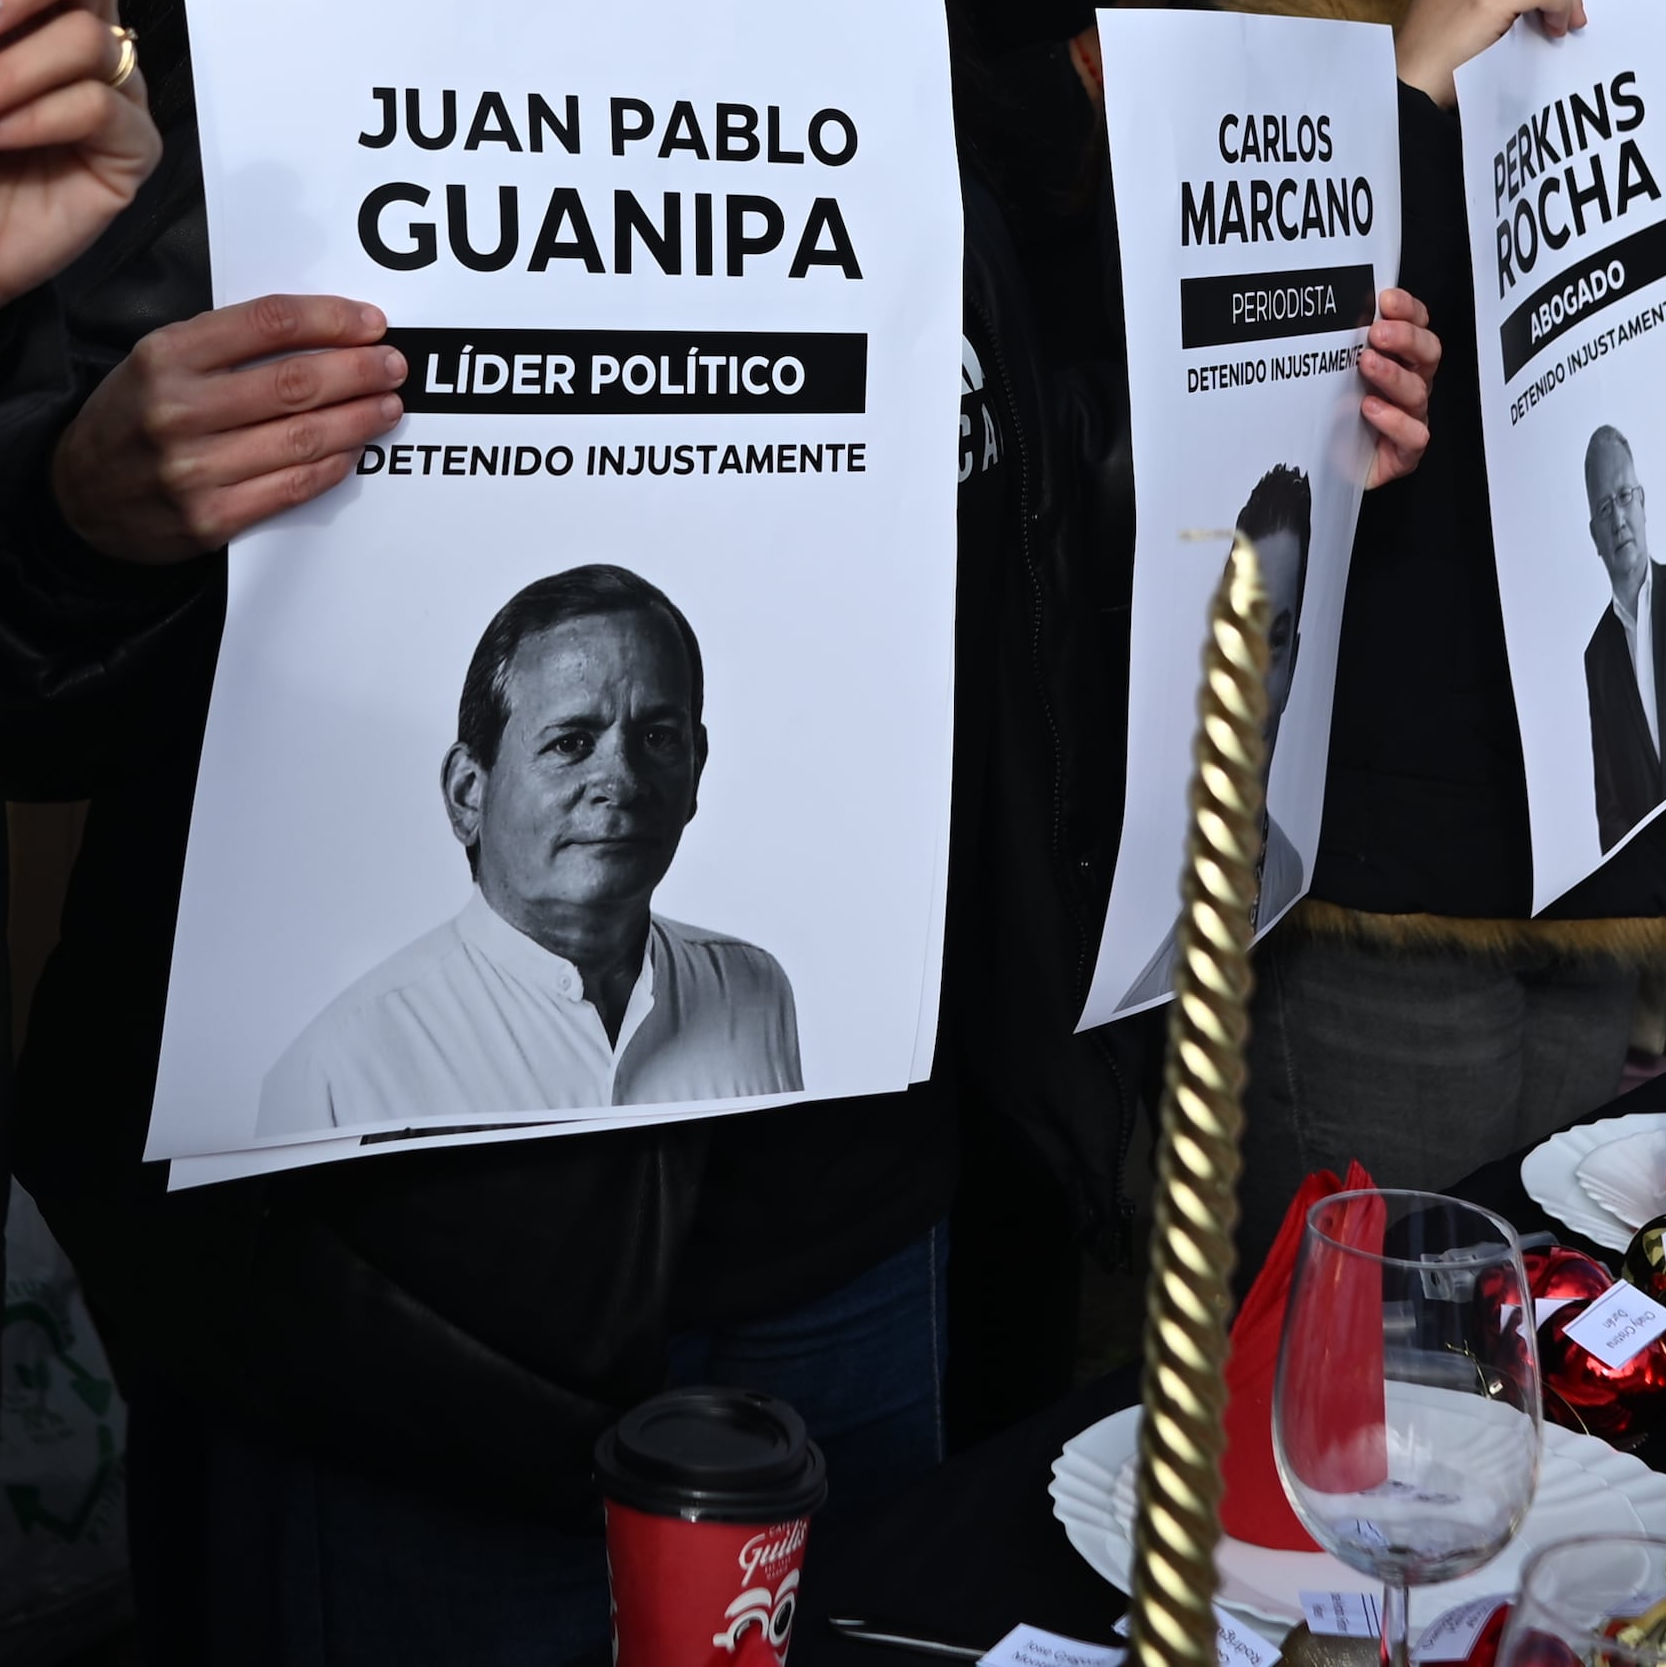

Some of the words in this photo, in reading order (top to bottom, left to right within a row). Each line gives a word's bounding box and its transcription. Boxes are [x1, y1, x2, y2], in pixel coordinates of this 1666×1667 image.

[358, 86, 580, 155] JUAN
[609, 96, 859, 167] PABLO
[1218, 113, 1333, 164] CARLOS
[1493, 70, 1646, 219] PERKINS
[357, 181, 864, 281] GUANIPA
[1180, 175, 1374, 247] MARCANO
[1496, 138, 1663, 301] ROCHA
[1231, 283, 1338, 325] PERIODISTA
[1530, 259, 1625, 346] ABOGADO
[424, 344, 575, 395] LÍDER
[590, 346, 806, 396] POLÍTICO
[1187, 359, 1267, 394] DETENIDO
[1270, 343, 1364, 382] INJUSTAMENTE
[1509, 362, 1566, 427] DETENIDO
[357, 444, 574, 477] DETENIDO
[586, 442, 867, 478] INJUSTAMENTE
